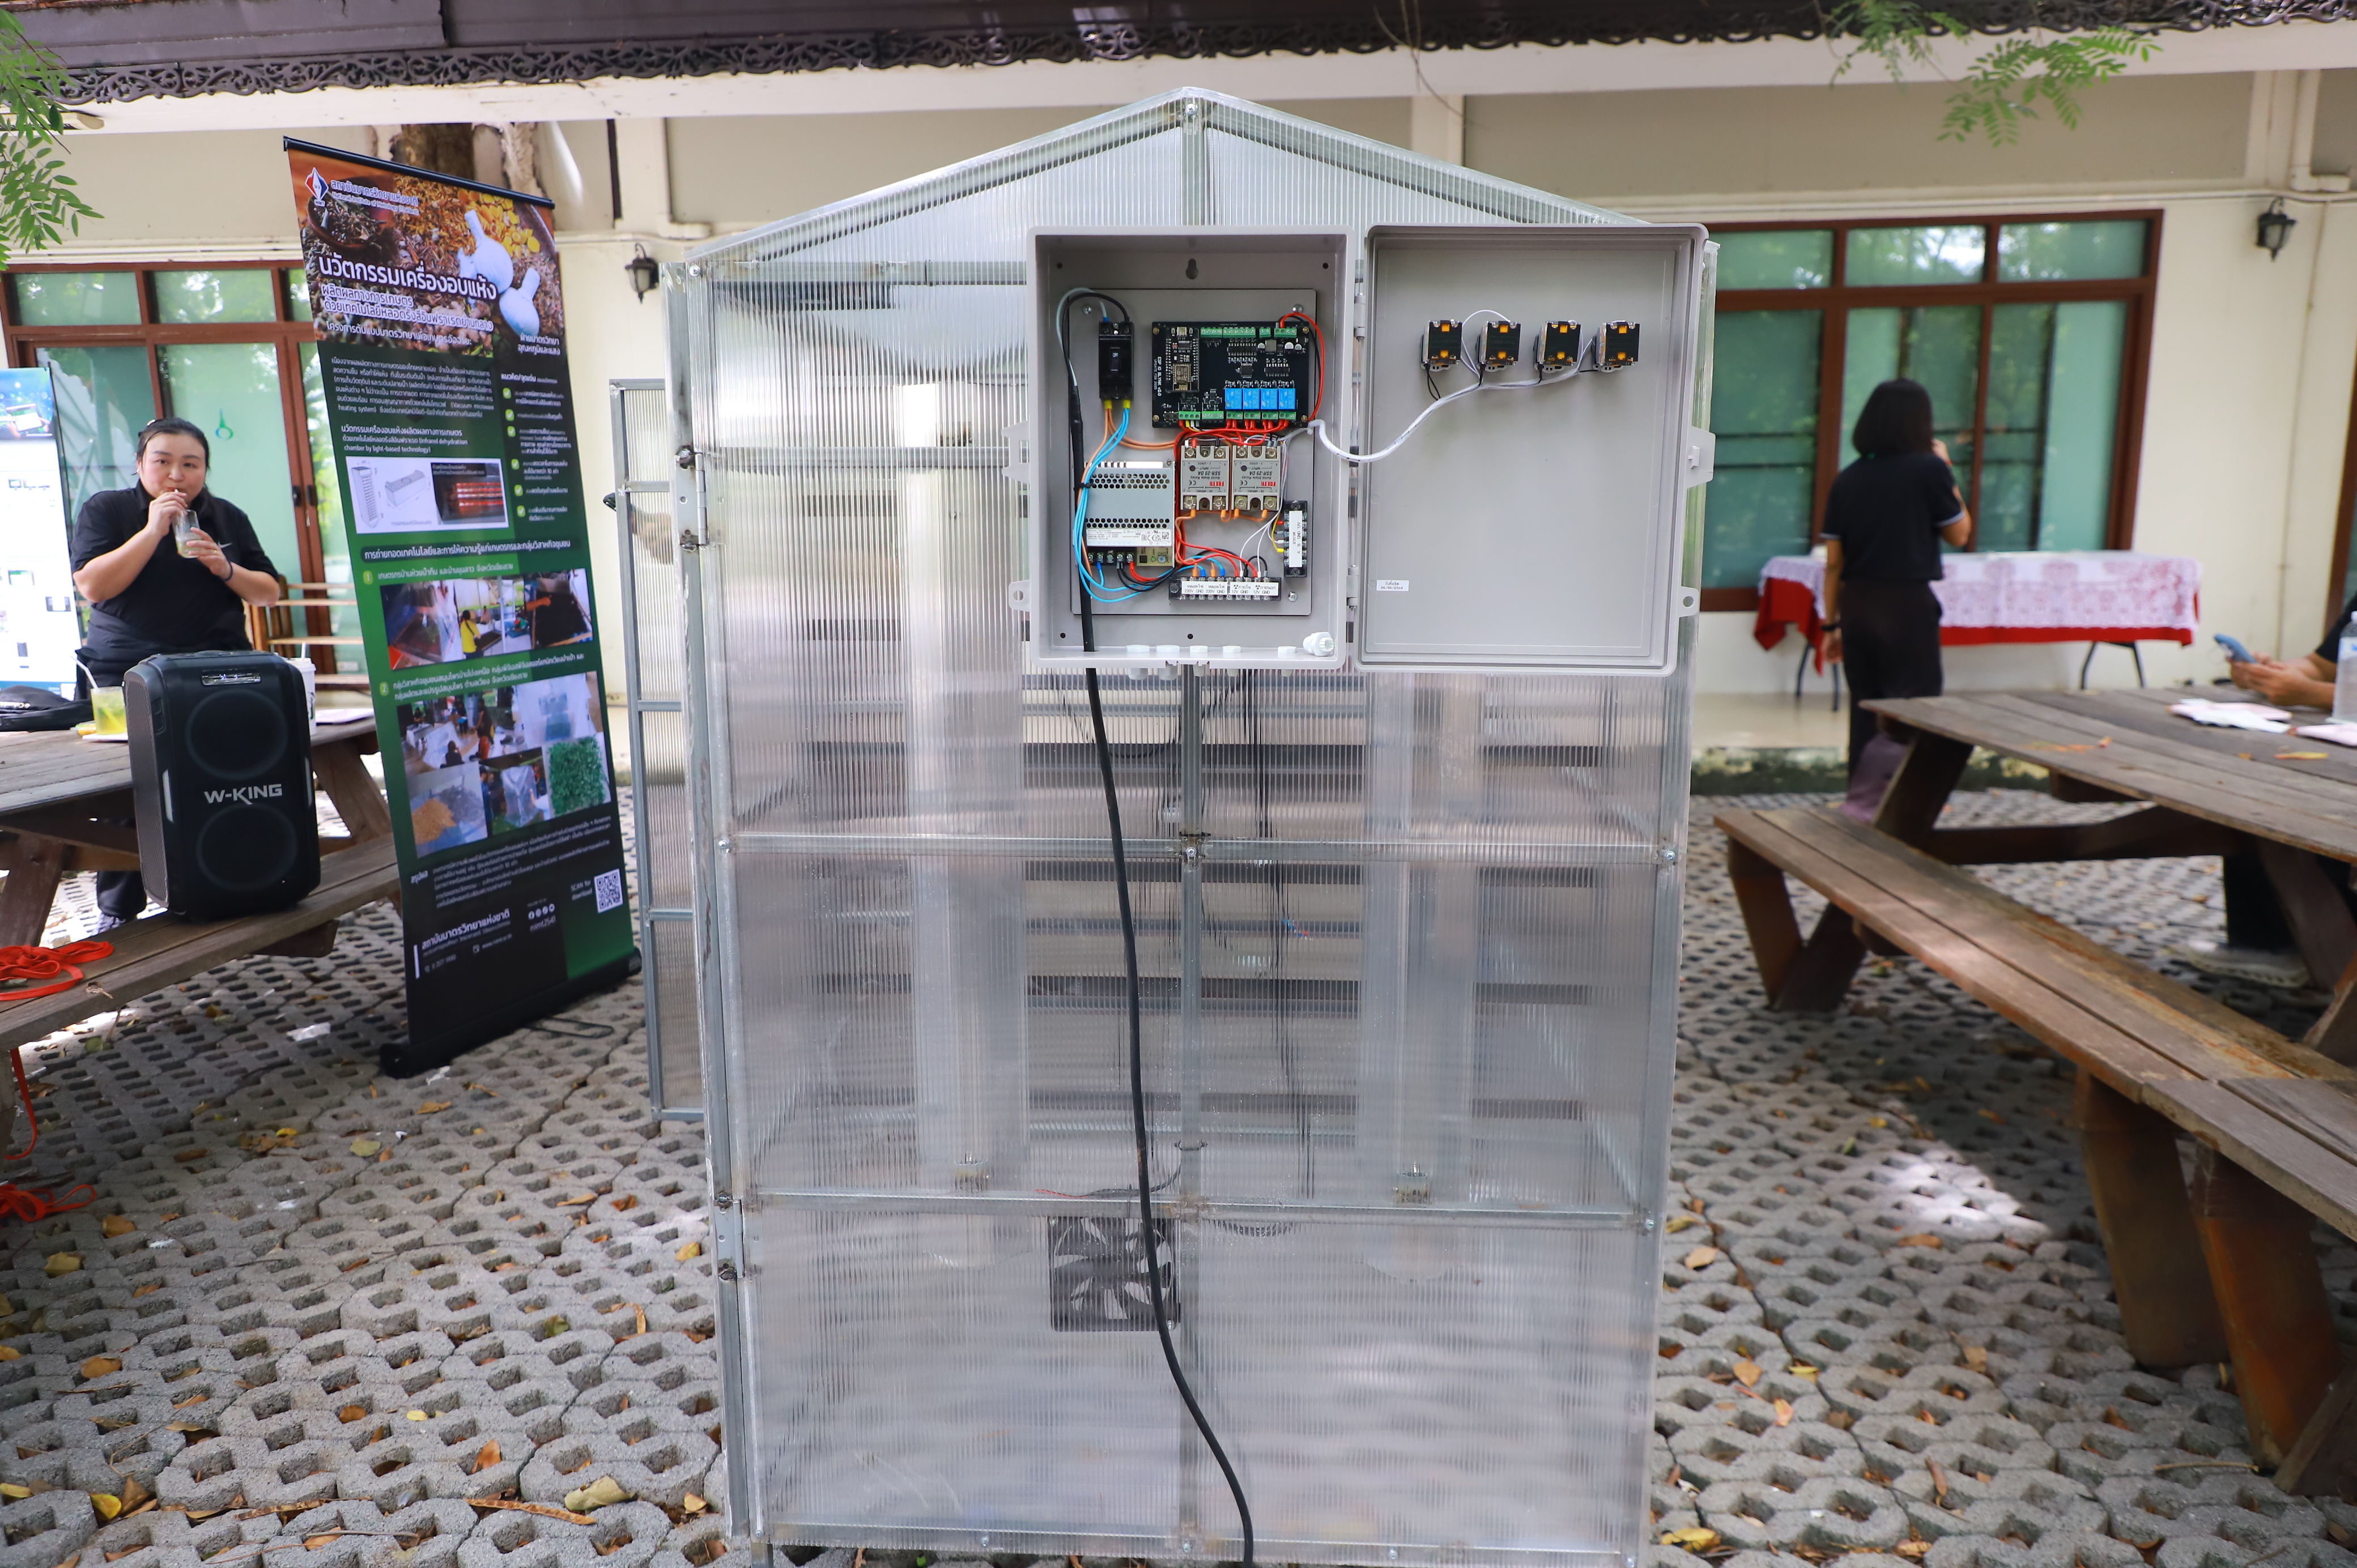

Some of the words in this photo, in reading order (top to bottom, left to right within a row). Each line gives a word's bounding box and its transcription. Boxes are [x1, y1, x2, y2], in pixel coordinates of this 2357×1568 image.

[331, 180, 419, 207] สถาบันมาตรวิทยาแห่งชาติ
[318, 253, 497, 300] นวัตกรรมเครื่องอบแห้ง
[321, 283, 414, 308] ผลิตผลทางการเกษตร
[204, 783, 282, 805] W-KING
